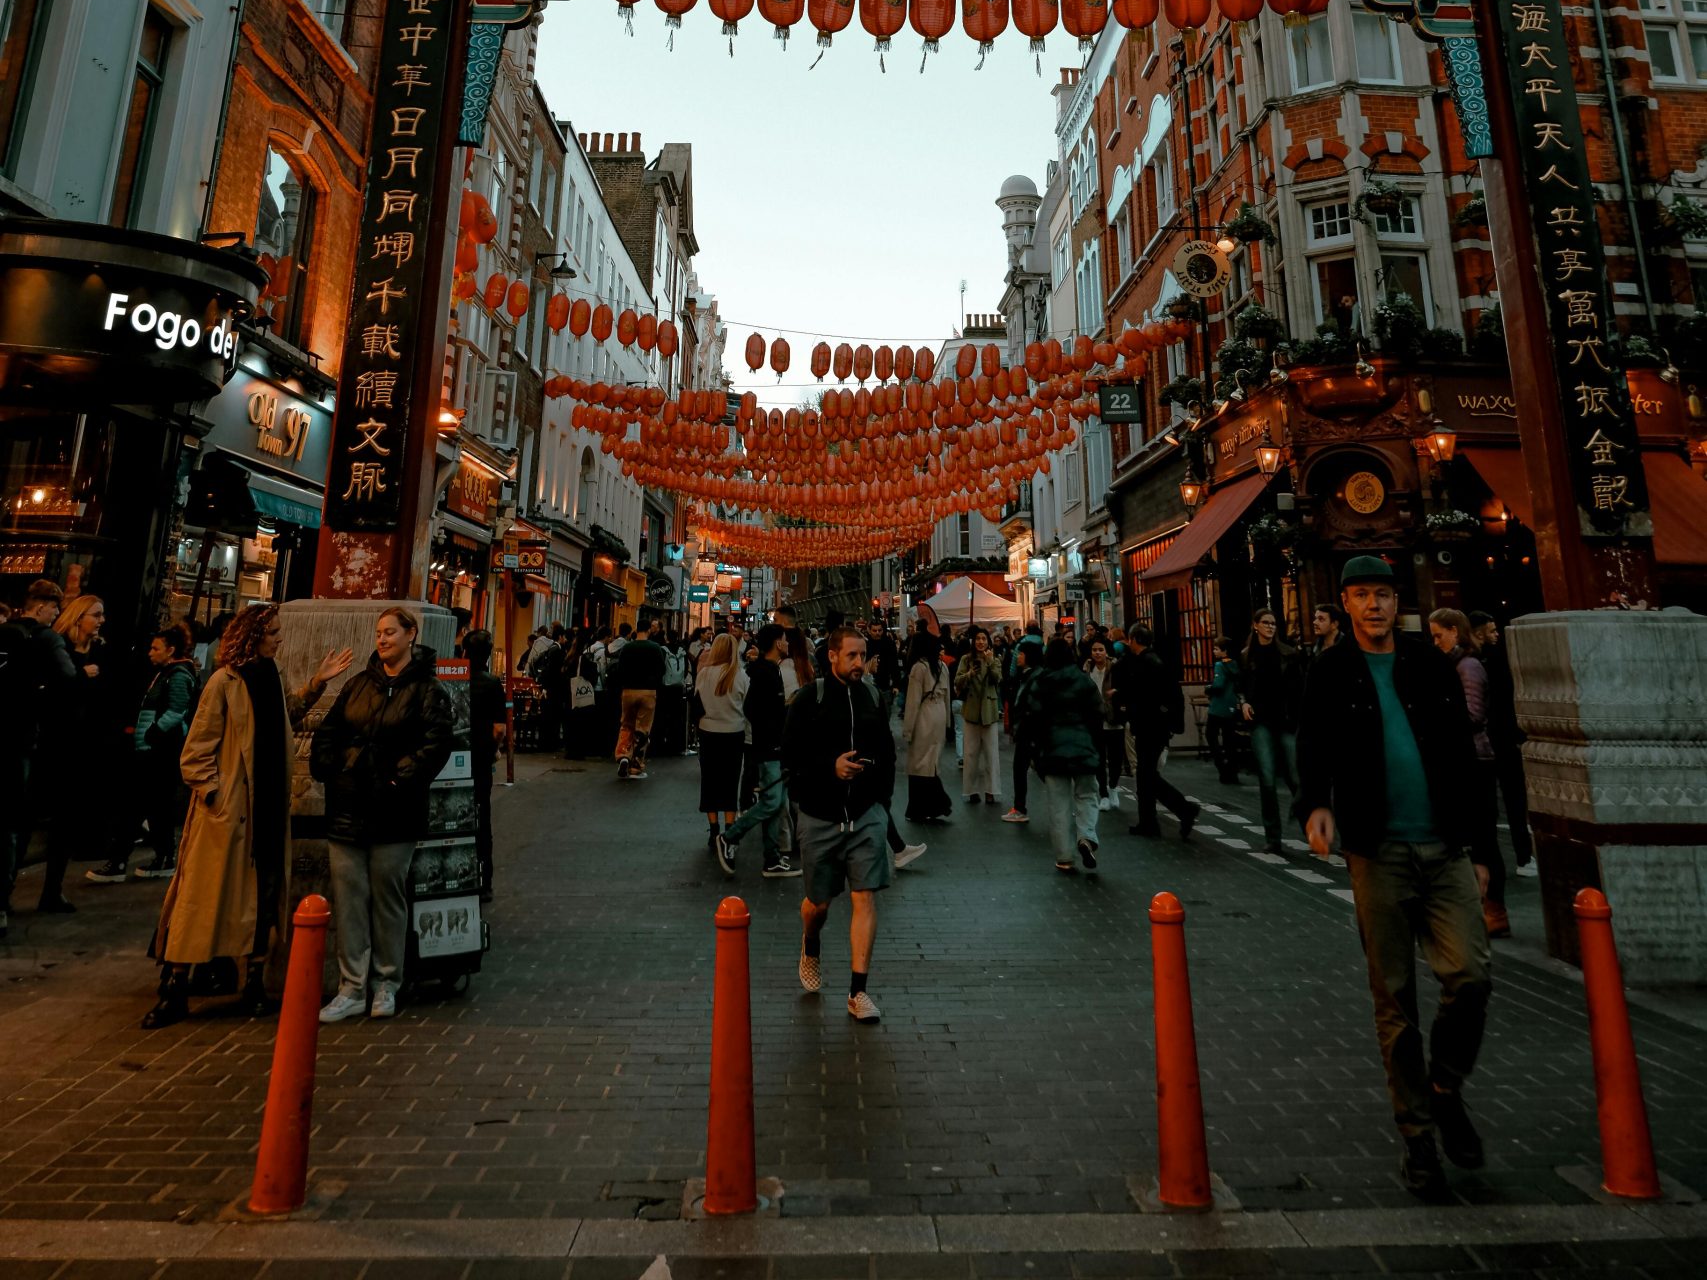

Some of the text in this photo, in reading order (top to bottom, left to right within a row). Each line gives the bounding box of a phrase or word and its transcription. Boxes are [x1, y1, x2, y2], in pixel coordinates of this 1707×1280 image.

[103, 292, 201, 350] Fogo
[248, 391, 279, 430] Old
[1110, 393, 1131, 409] 22
[256, 424, 283, 457] Town
